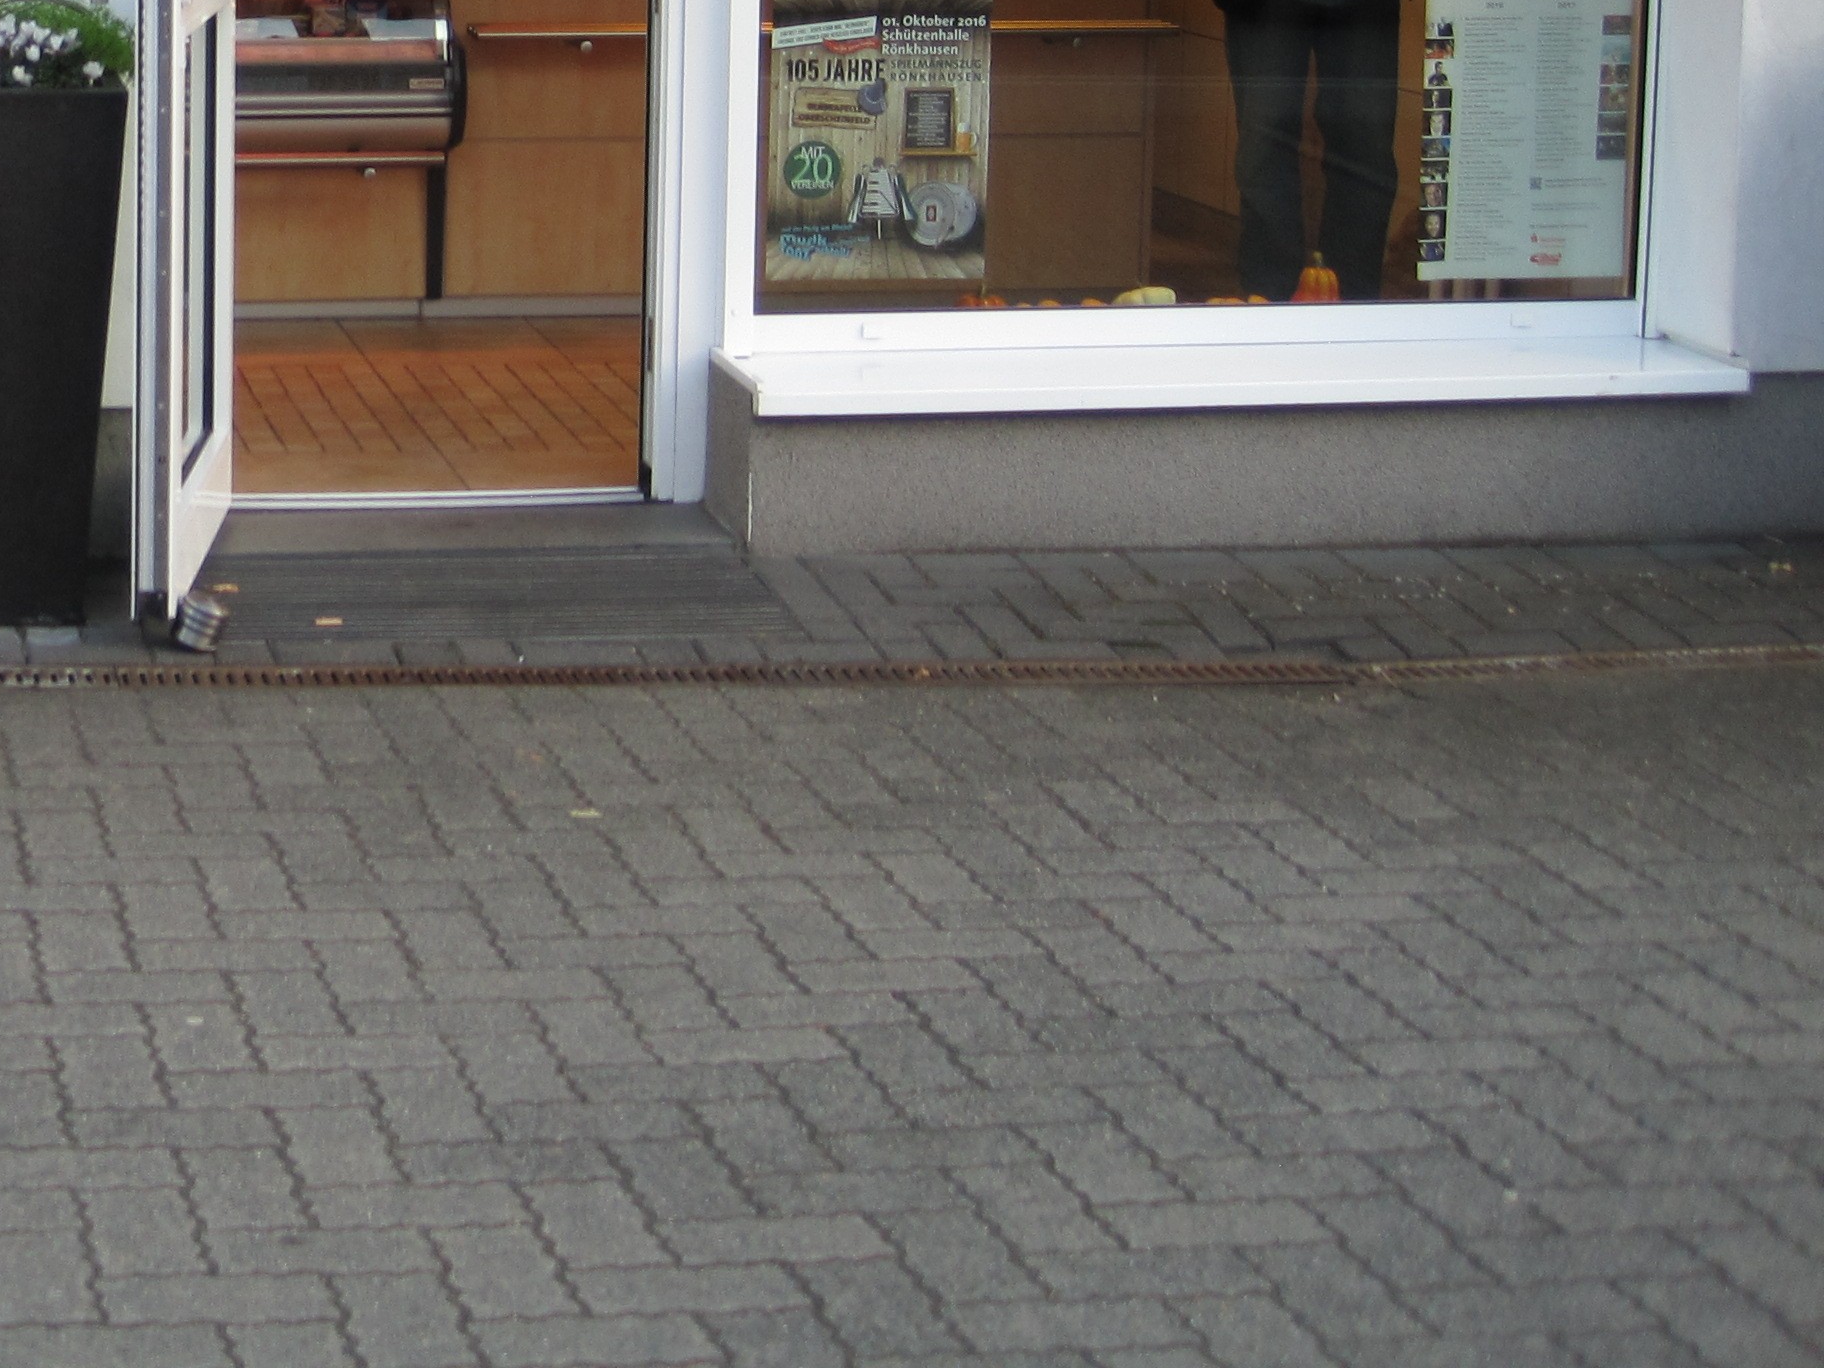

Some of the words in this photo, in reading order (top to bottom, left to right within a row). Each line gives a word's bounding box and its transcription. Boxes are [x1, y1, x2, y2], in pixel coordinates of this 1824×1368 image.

[882, 16, 900, 28] 01.
[903, 14, 955, 27] Oktober
[957, 15, 987, 27] 2016
[881, 28, 970, 41] Schützenhalle
[881, 42, 959, 55] Rönkhausen
[786, 59, 819, 82] 105
[823, 59, 886, 82] JAHRE
[801, 146, 825, 159] MIT
[792, 154, 833, 182] 20
